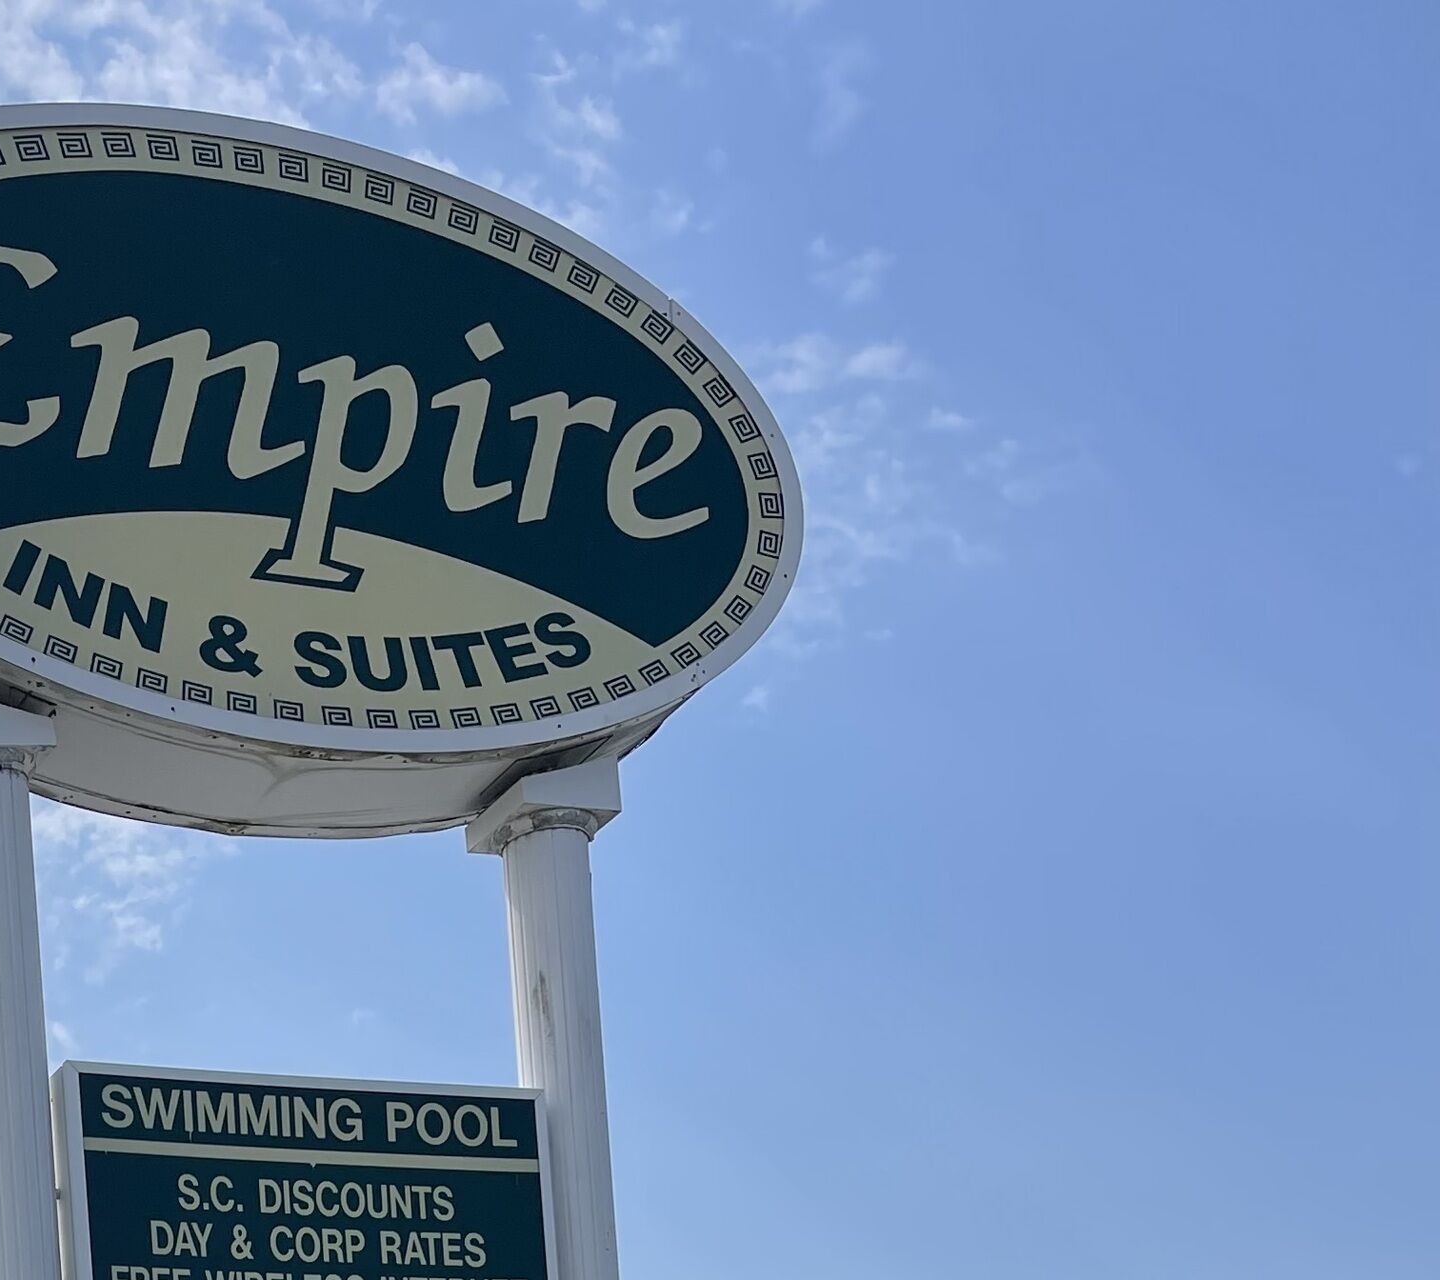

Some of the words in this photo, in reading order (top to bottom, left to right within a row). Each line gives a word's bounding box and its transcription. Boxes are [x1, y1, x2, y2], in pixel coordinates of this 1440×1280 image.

[3, 540, 168, 653] INN
[199, 615, 263, 678] &
[294, 612, 591, 692] SUITES
[102, 1085, 362, 1140] SWIMMING
[387, 1102, 517, 1146] POOL
[179, 1175, 242, 1211] S.C.
[259, 1180, 454, 1220] DISCOUNTS
[151, 1221, 212, 1256] DAY
[231, 1225, 253, 1259] &
[271, 1226, 364, 1262] CORP
[381, 1231, 485, 1267] RATES
